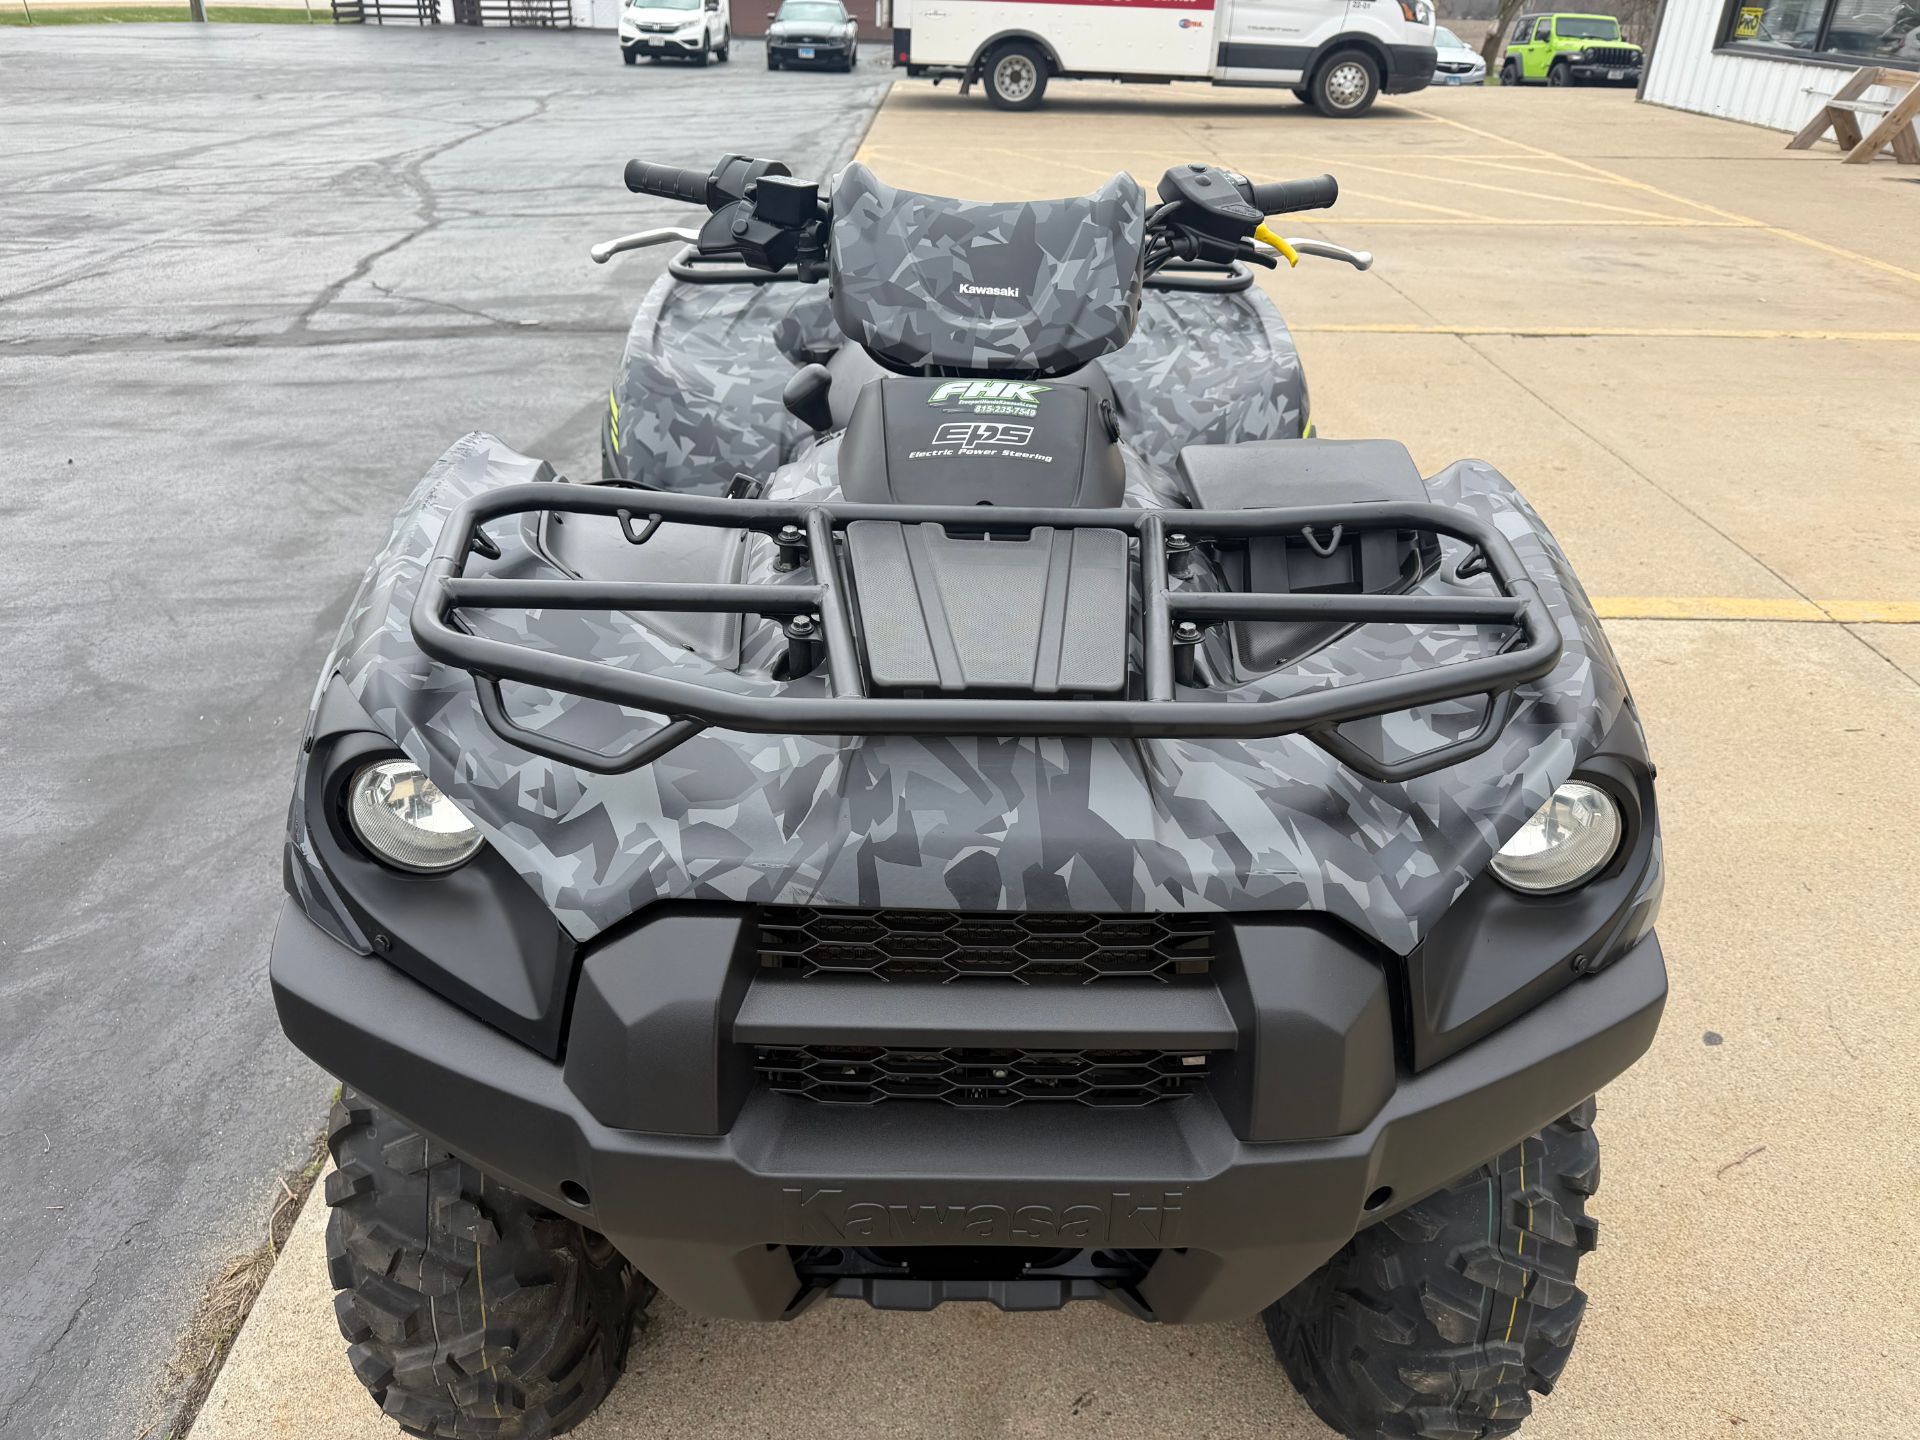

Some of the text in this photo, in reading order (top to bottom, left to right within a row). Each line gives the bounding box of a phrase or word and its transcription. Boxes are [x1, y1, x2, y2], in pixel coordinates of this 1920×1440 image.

[959, 283, 1019, 297] Kawasaki
[928, 380, 1053, 403] FHK
[974, 404, 1037, 417] 815-235-7549
[909, 449, 953, 458] Electric
[1002, 449, 1052, 462] Steering
[782, 1188, 1183, 1242] Kawasaki
